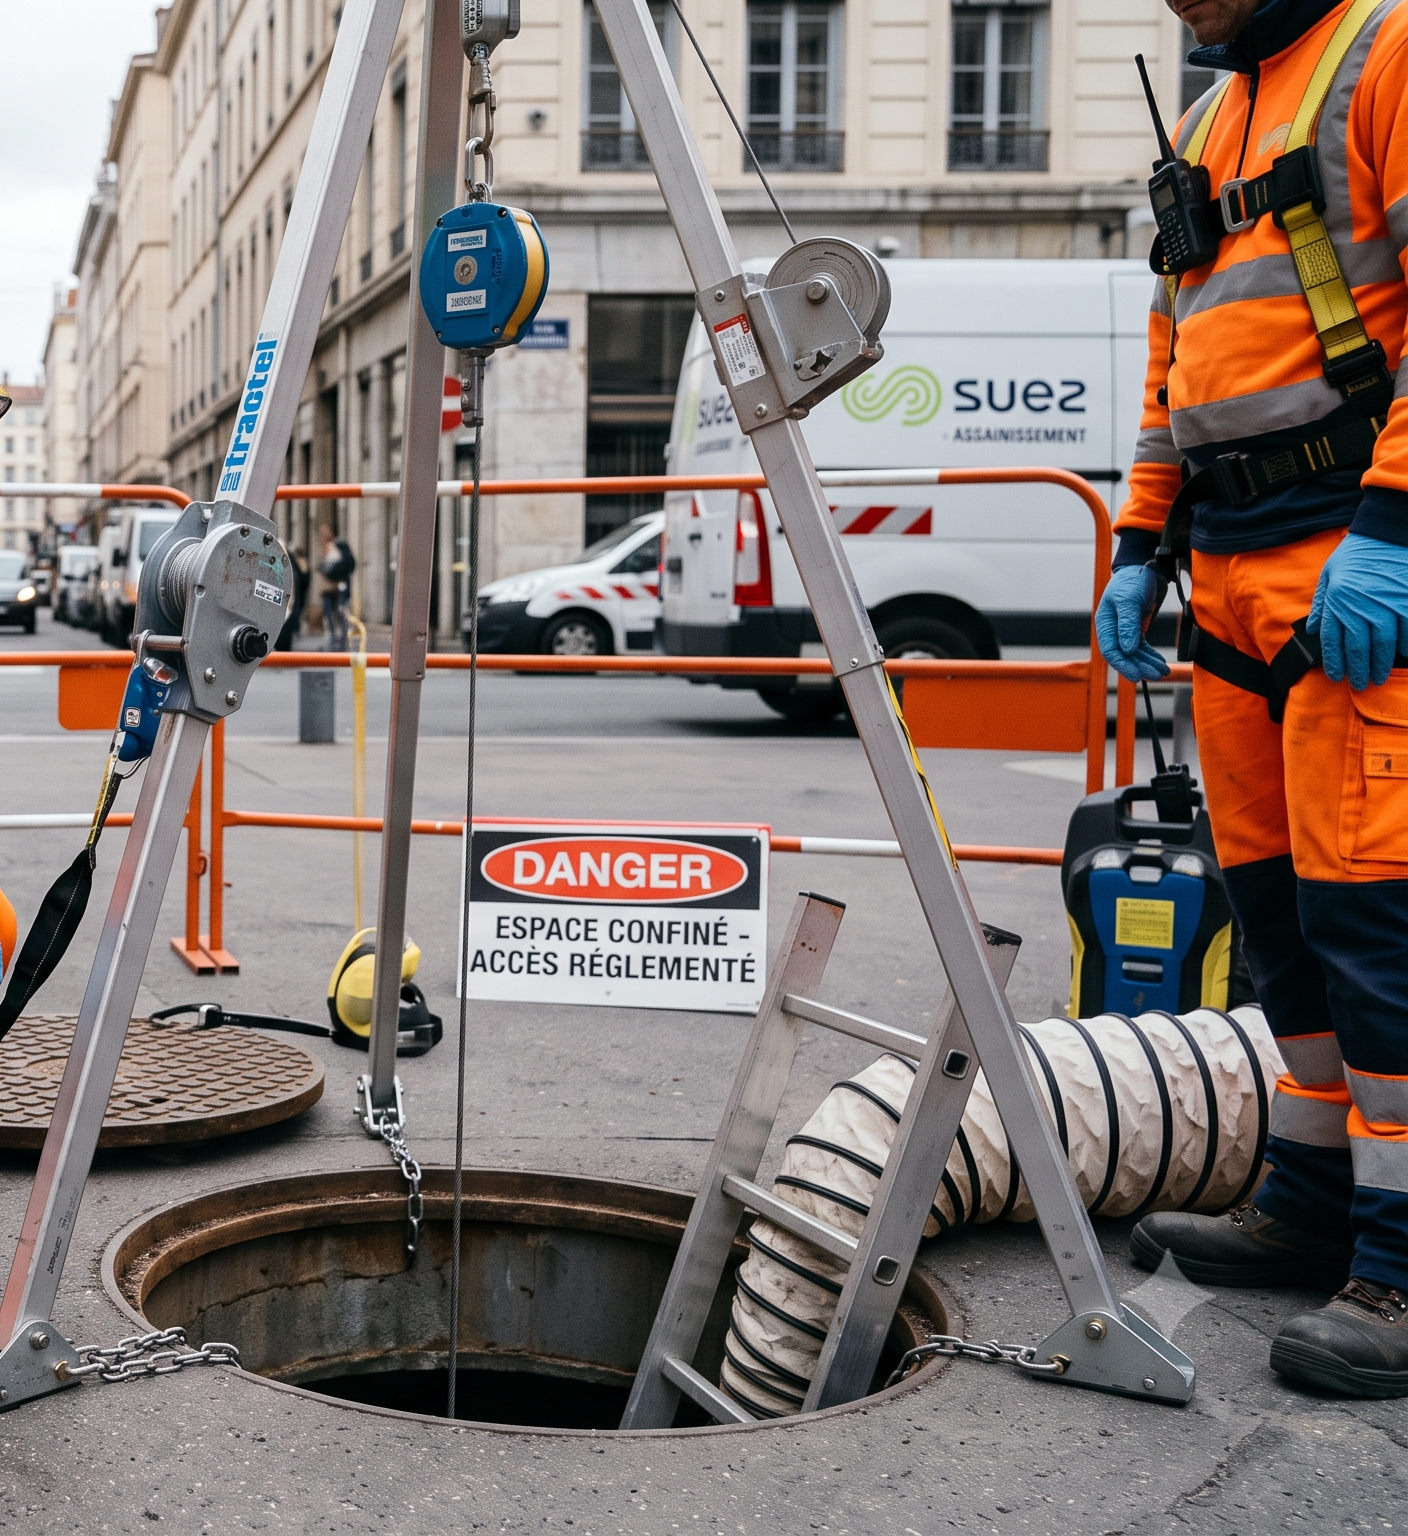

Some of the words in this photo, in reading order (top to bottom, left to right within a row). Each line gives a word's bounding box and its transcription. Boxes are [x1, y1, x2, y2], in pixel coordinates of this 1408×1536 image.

[225, 339, 278, 468] tractel
[954, 380, 1086, 412] suez
[953, 427, 1086, 442] ASSAINISSEMENT
[513, 850, 712, 890] DANGER
[495, 915, 599, 942] ESPACE
[608, 916, 728, 946] CONFINÉ
[470, 946, 559, 976] ACCÈS
[569, 948, 755, 983] RÉGLEMENTÉ
